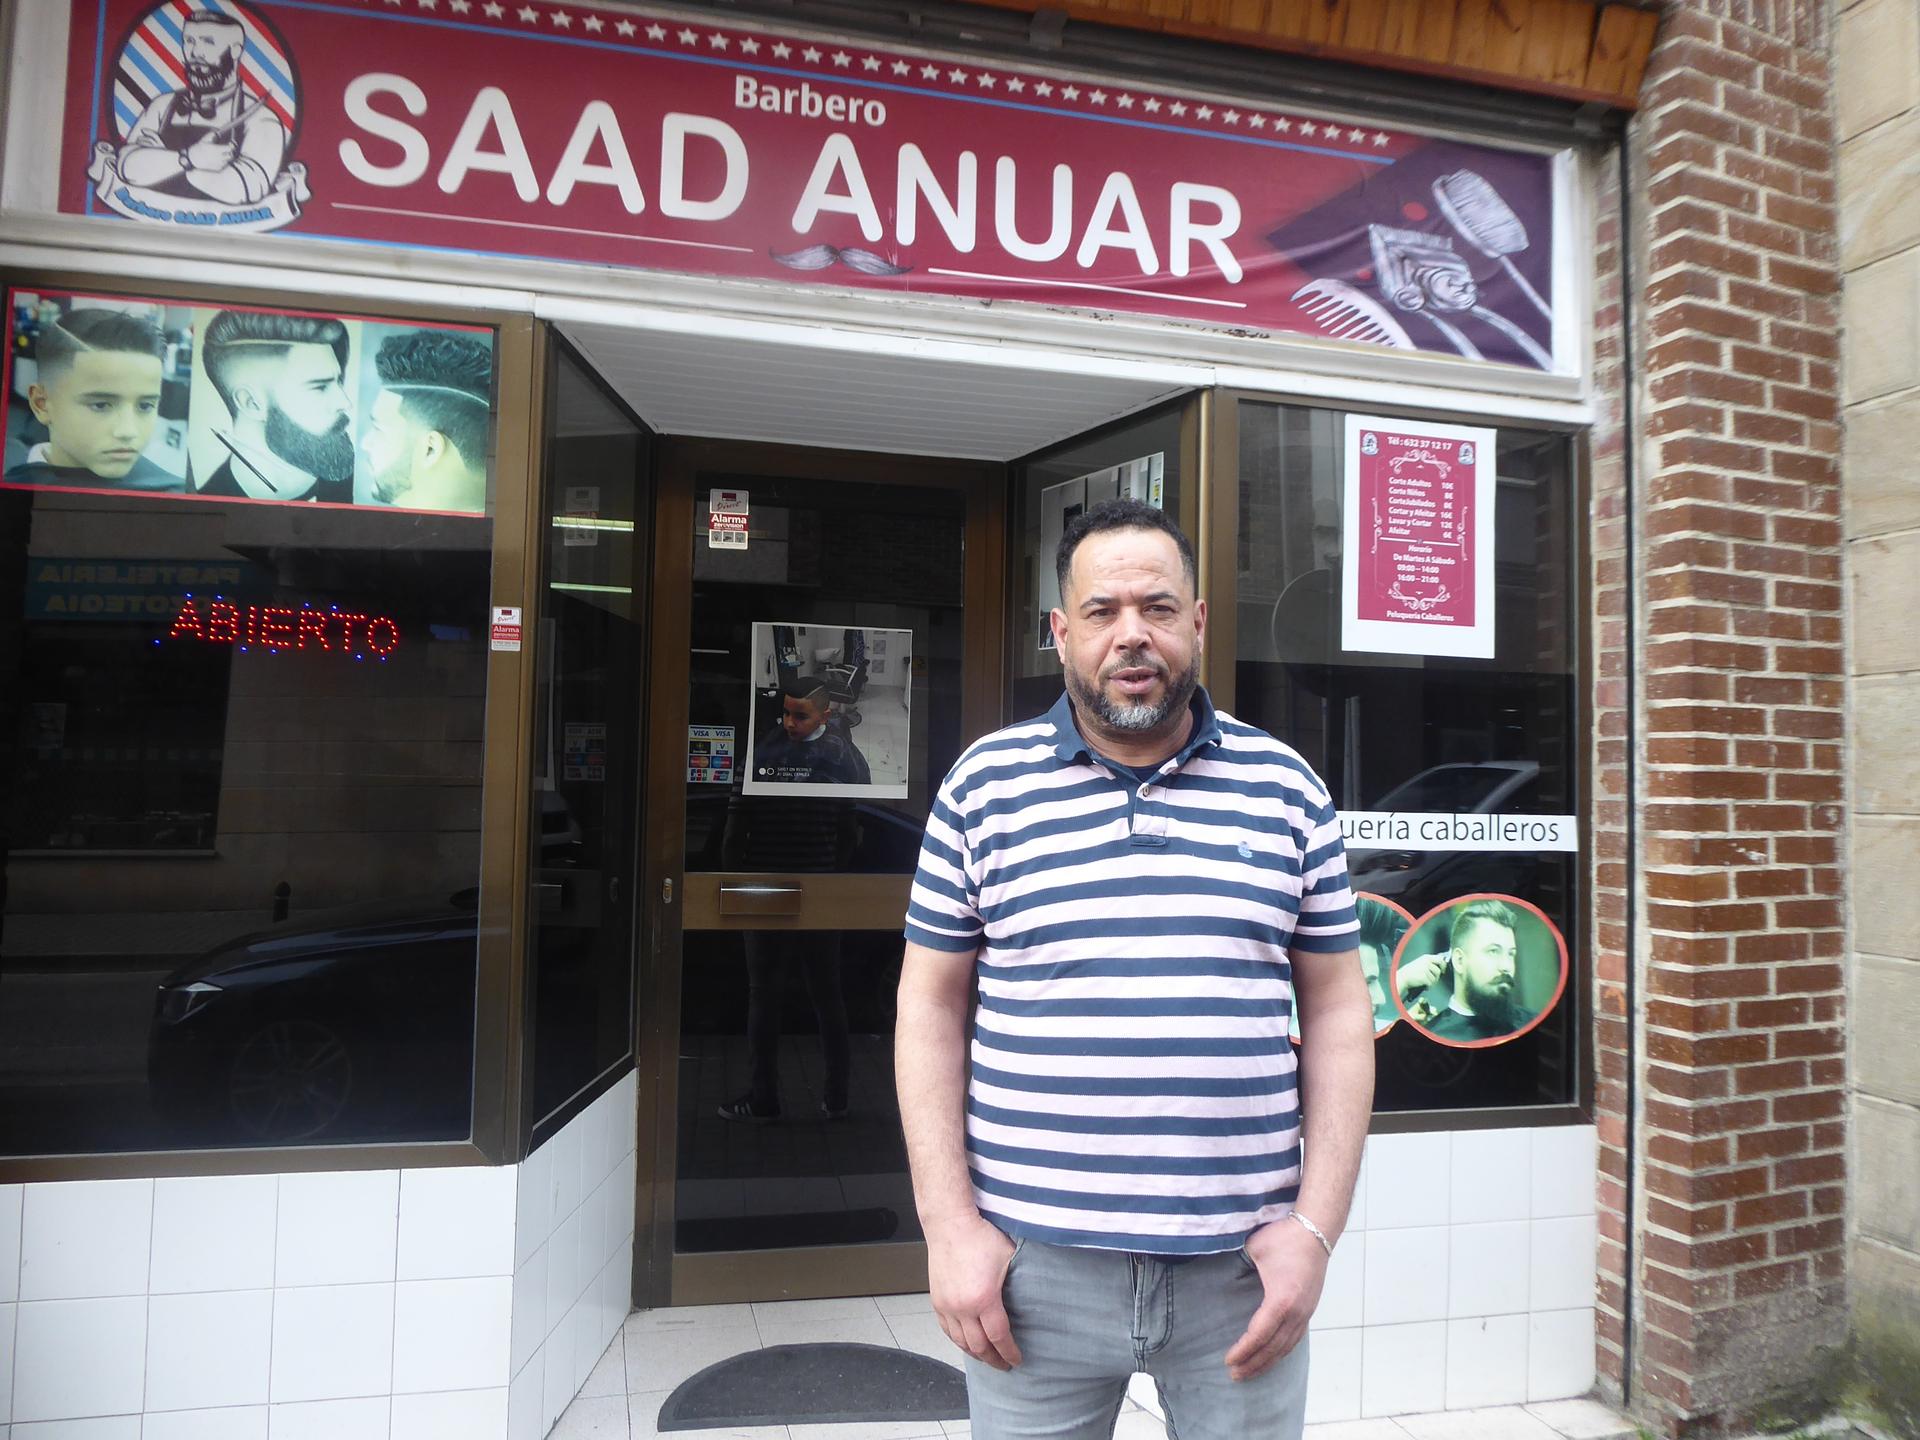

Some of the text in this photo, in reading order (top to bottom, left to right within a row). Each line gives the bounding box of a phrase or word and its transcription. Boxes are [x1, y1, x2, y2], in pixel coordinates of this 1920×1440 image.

[735, 74, 887, 126] Barbero
[339, 72, 1244, 284] SAAD ANUAR
[173, 208, 217, 225] SAAD
[218, 207, 274, 225] ANUAR
[1420, 440, 1430, 448] 37
[1431, 441, 1442, 450] 12
[1442, 442, 1452, 450] 17
[1388, 477, 1406, 486] Corte
[1388, 487, 1406, 495] Corte
[1388, 496, 1406, 505] Corte
[711, 513, 747, 524] Alarma
[1403, 554, 1425, 563] Martes
[169, 600, 400, 654] ABIERTO
[493, 625, 520, 633] Alarma
[1420, 813, 1560, 842] caballeros
